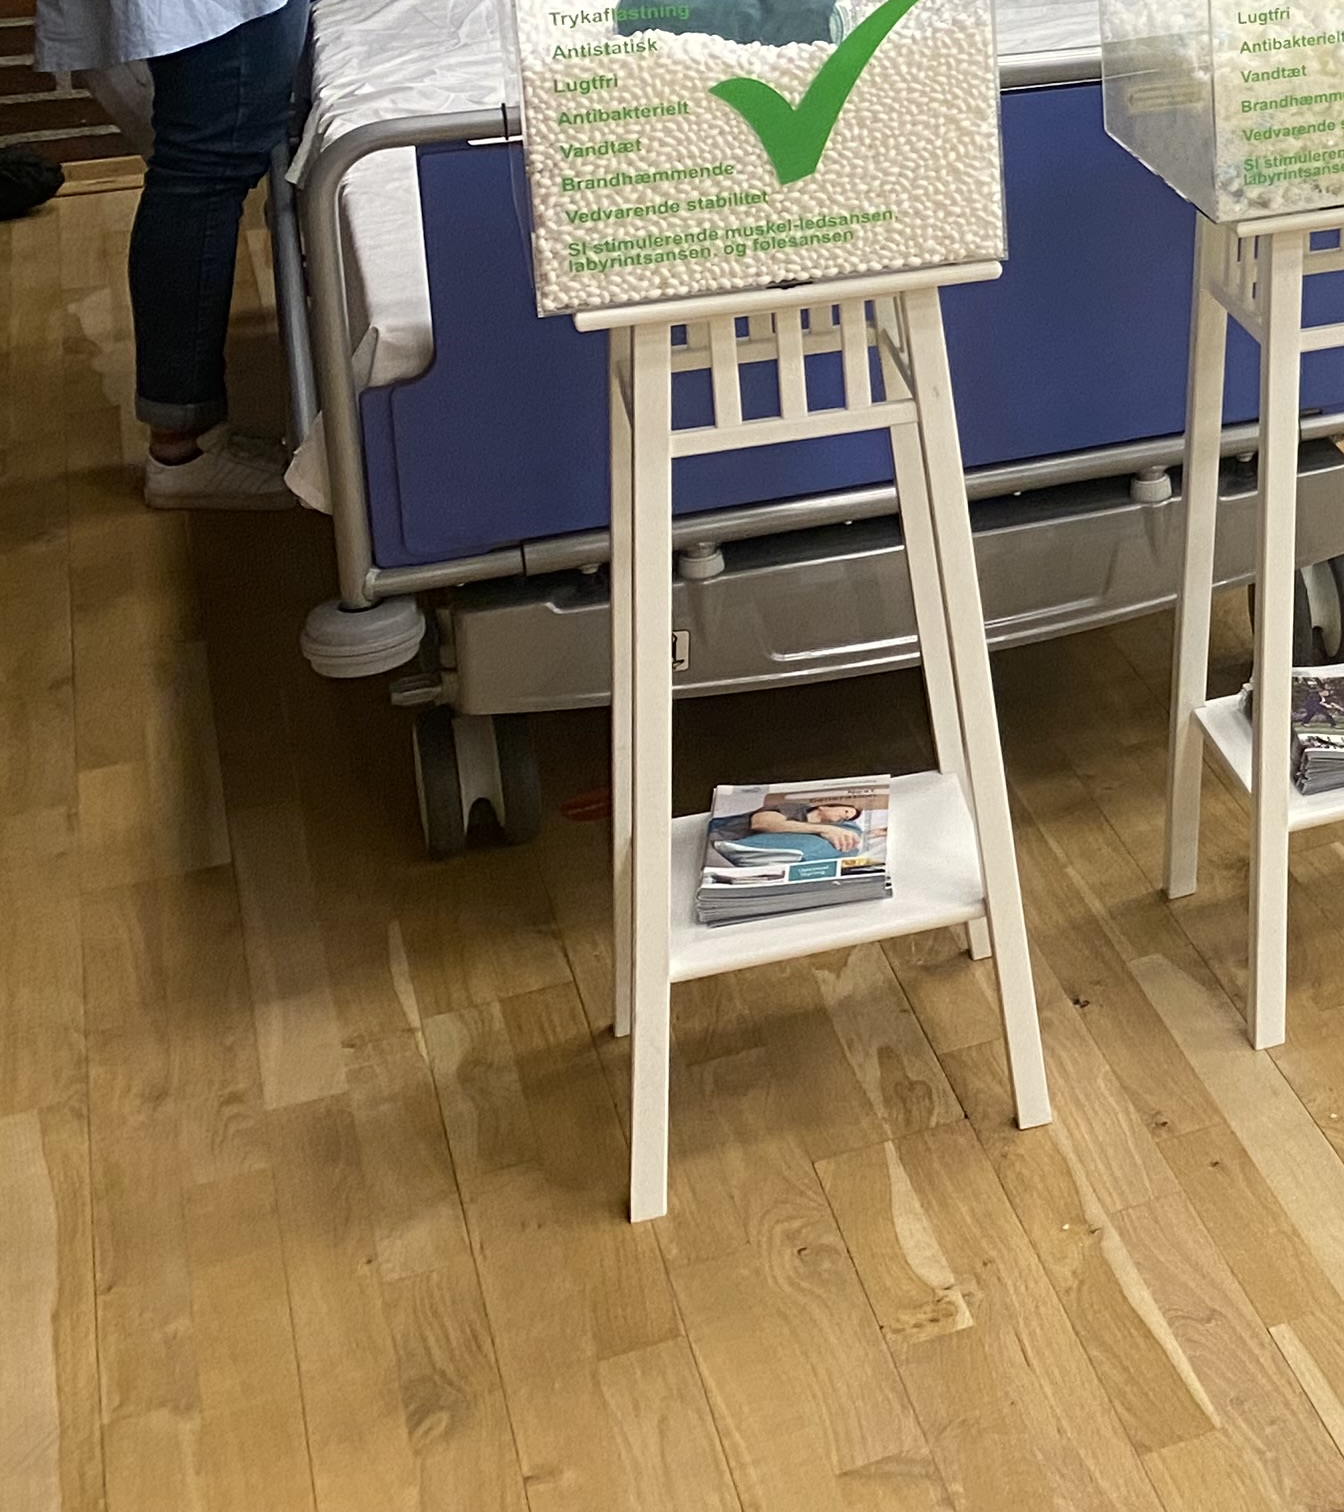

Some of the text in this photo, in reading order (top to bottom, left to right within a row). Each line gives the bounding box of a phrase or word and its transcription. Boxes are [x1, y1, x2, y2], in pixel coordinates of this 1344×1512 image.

[1237, 7, 1290, 26] Lugtfri
[552, 38, 658, 59] Antistatisk
[553, 74, 618, 95] Lugtfri
[1240, 65, 1308, 83] Vandtæt
[558, 101, 689, 126] Antibakterielt
[1242, 119, 1336, 141] Vedvarende
[559, 138, 642, 159] Vandtæt
[562, 162, 735, 192] Brandhæmmende
[565, 191, 769, 224] Vedvarende stabilitet
[593, 228, 718, 254] stimulerende
[724, 242, 746, 257] og
